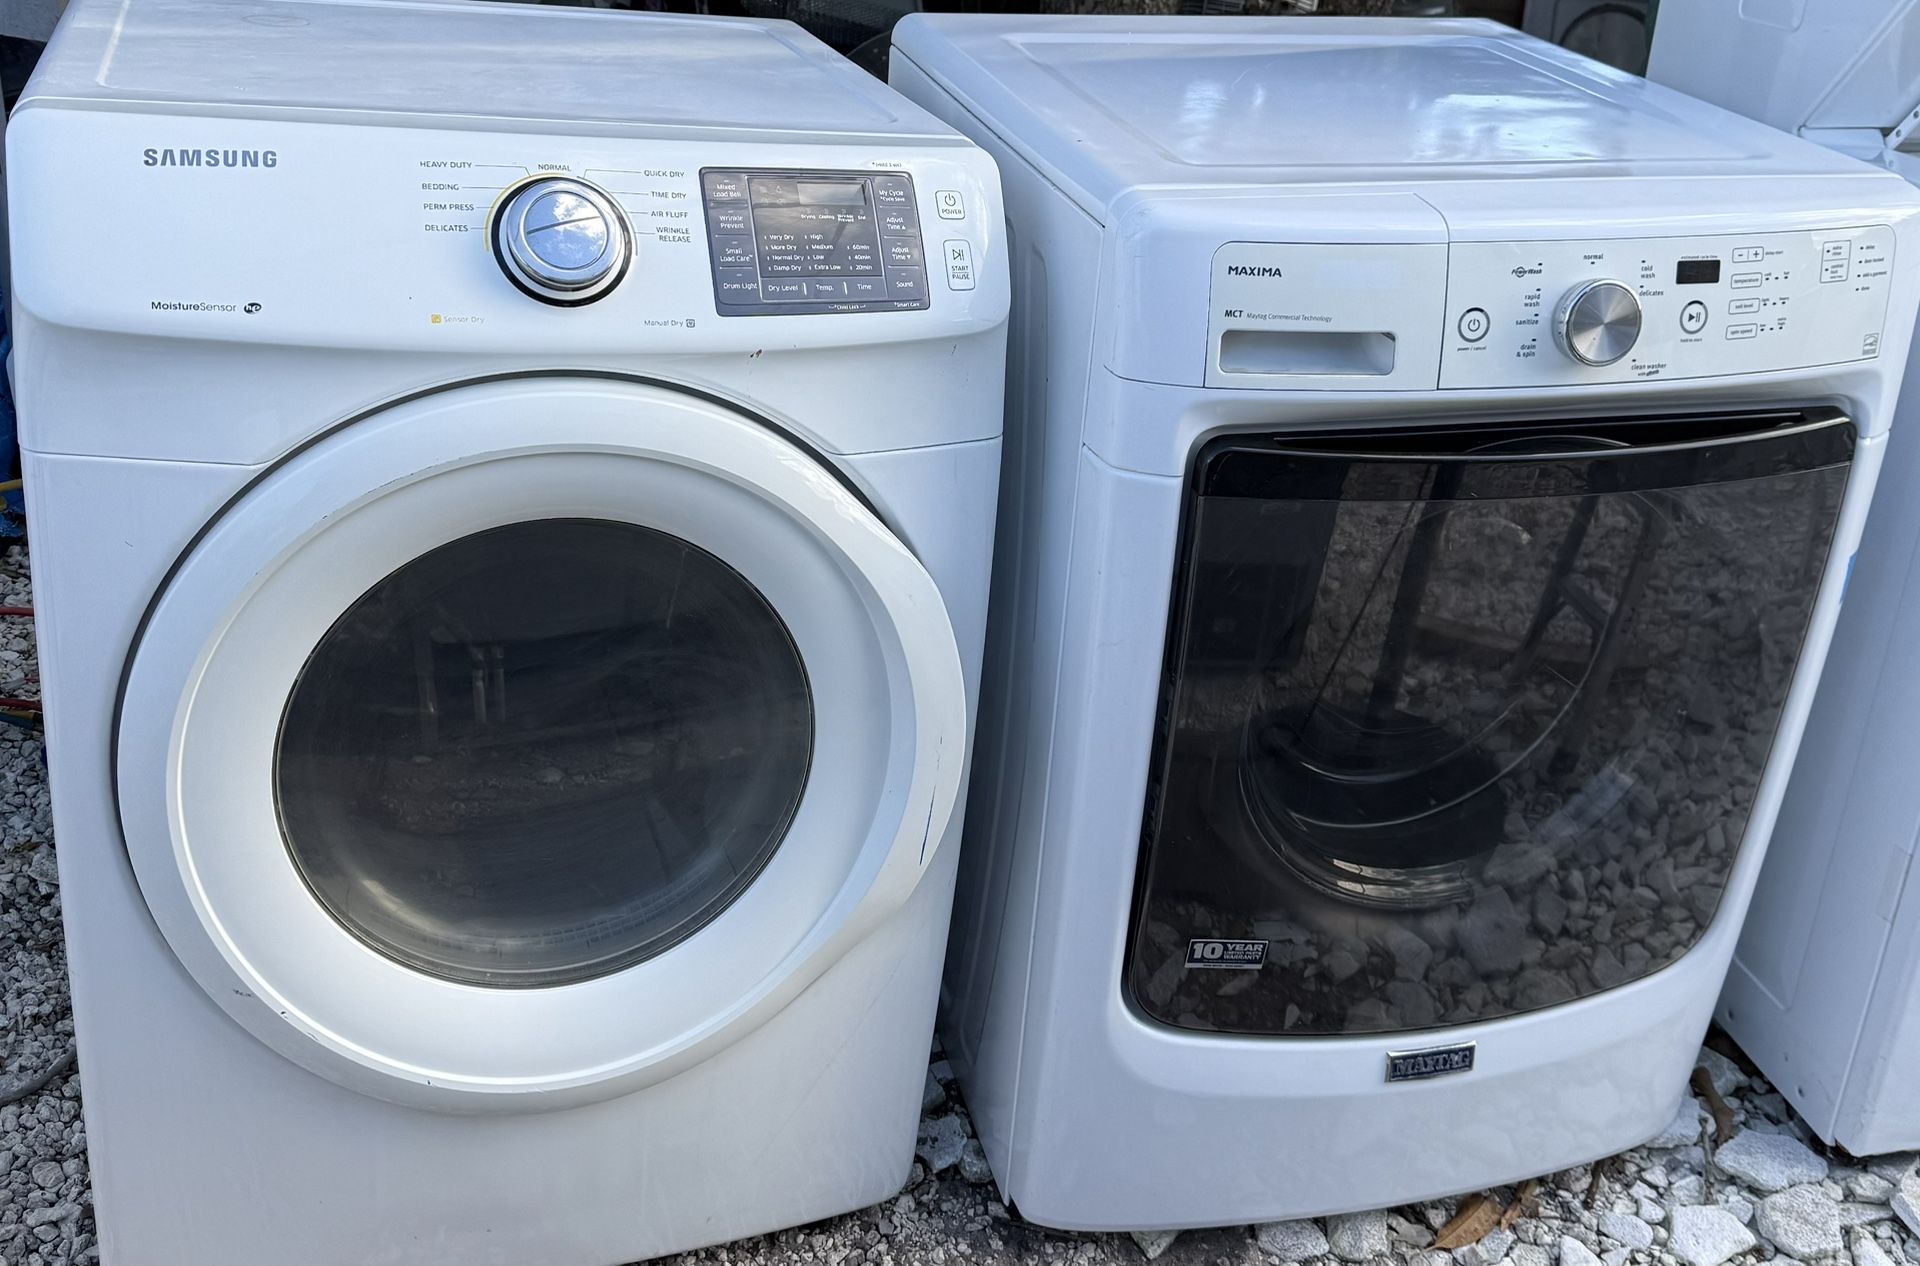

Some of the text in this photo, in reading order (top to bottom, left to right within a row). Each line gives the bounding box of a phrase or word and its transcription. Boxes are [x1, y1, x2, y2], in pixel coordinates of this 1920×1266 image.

[143, 148, 278, 168] SAMSUNG
[538, 164, 572, 172] NORMAL
[422, 183, 460, 191] BEDDING
[656, 226, 690, 234] WRINKLE
[659, 235, 692, 243] RELEASE
[1228, 265, 1282, 278] MAXIMA
[1524, 292, 1541, 301] rapid
[470, 316, 485, 326] Dry
[1224, 310, 1332, 323] MCT Maytag Commercial Technology
[670, 320, 684, 328] Dry
[1520, 343, 1536, 351] drain
[1194, 942, 1264, 959] 10 YEAR
[1394, 1050, 1470, 1074] MAYTAG
